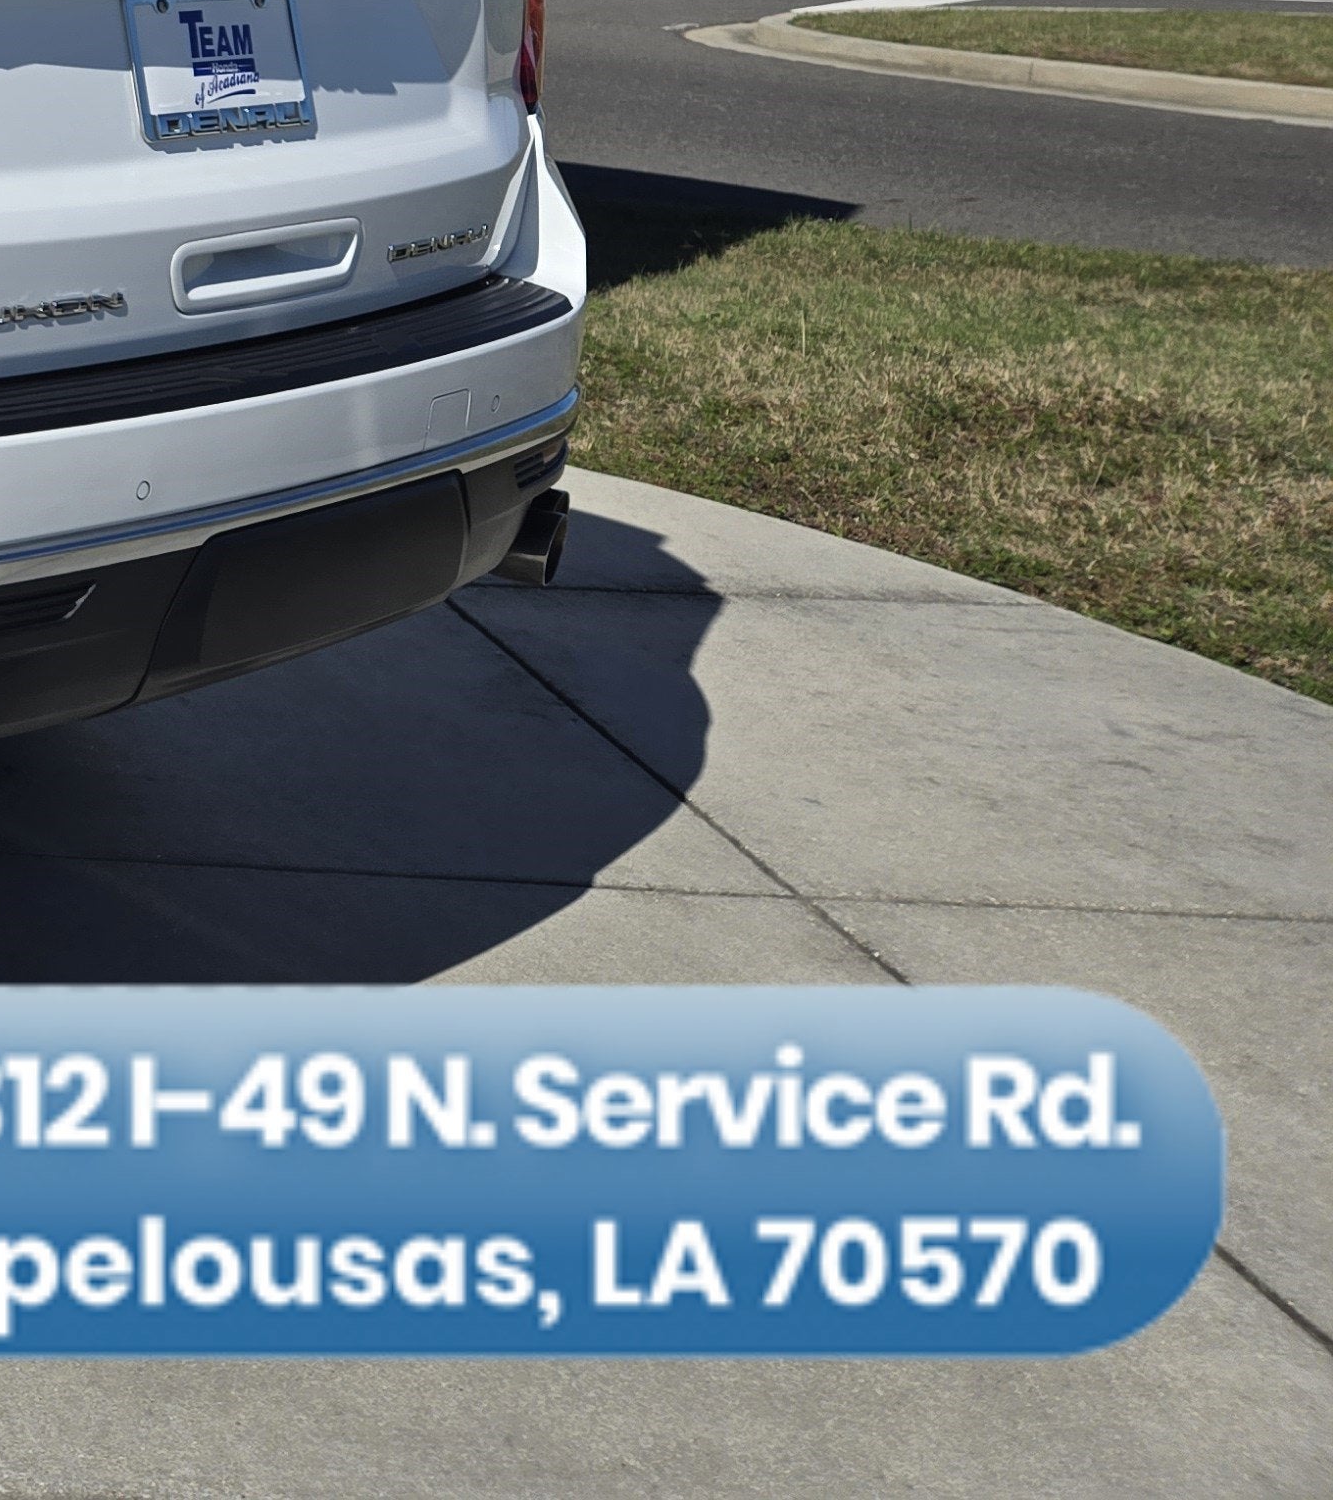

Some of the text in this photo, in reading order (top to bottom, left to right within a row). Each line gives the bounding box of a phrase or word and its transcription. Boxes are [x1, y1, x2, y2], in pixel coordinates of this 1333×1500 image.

[178, 10, 254, 58] TEAM
[211, 62, 240, 74] Honda
[195, 70, 261, 109] of Acadiana
[156, 101, 311, 140] DENALI
[387, 223, 489, 263] DENALI
